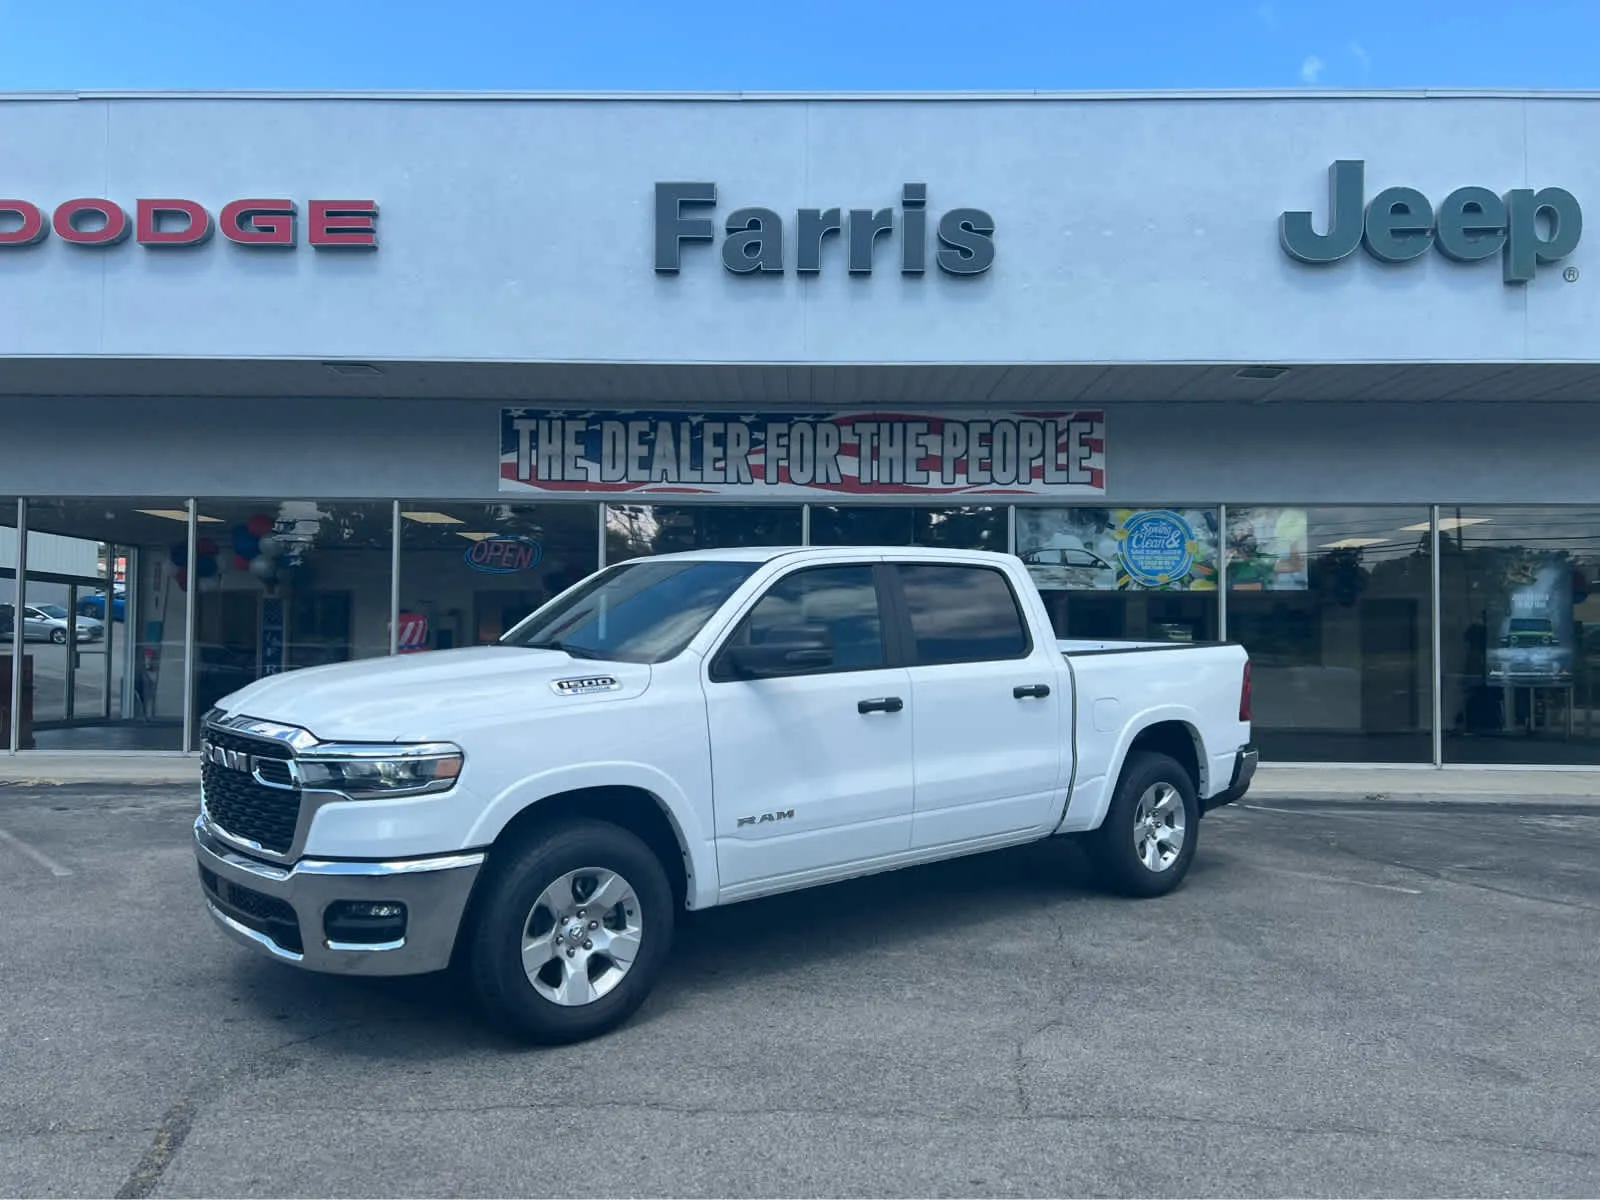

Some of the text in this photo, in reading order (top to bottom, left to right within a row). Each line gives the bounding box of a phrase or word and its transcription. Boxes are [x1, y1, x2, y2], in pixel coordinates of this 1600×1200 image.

[0, 198, 378, 250] DODGE
[654, 182, 995, 275] Farris
[1279, 159, 1583, 283] Jeep
[513, 418, 1094, 485] THE DEALER FOR THE PEOPLE
[471, 540, 533, 569] OPEN
[1132, 531, 1166, 549] Clean
[200, 739, 248, 773] RAM
[737, 809, 795, 828] RAM
